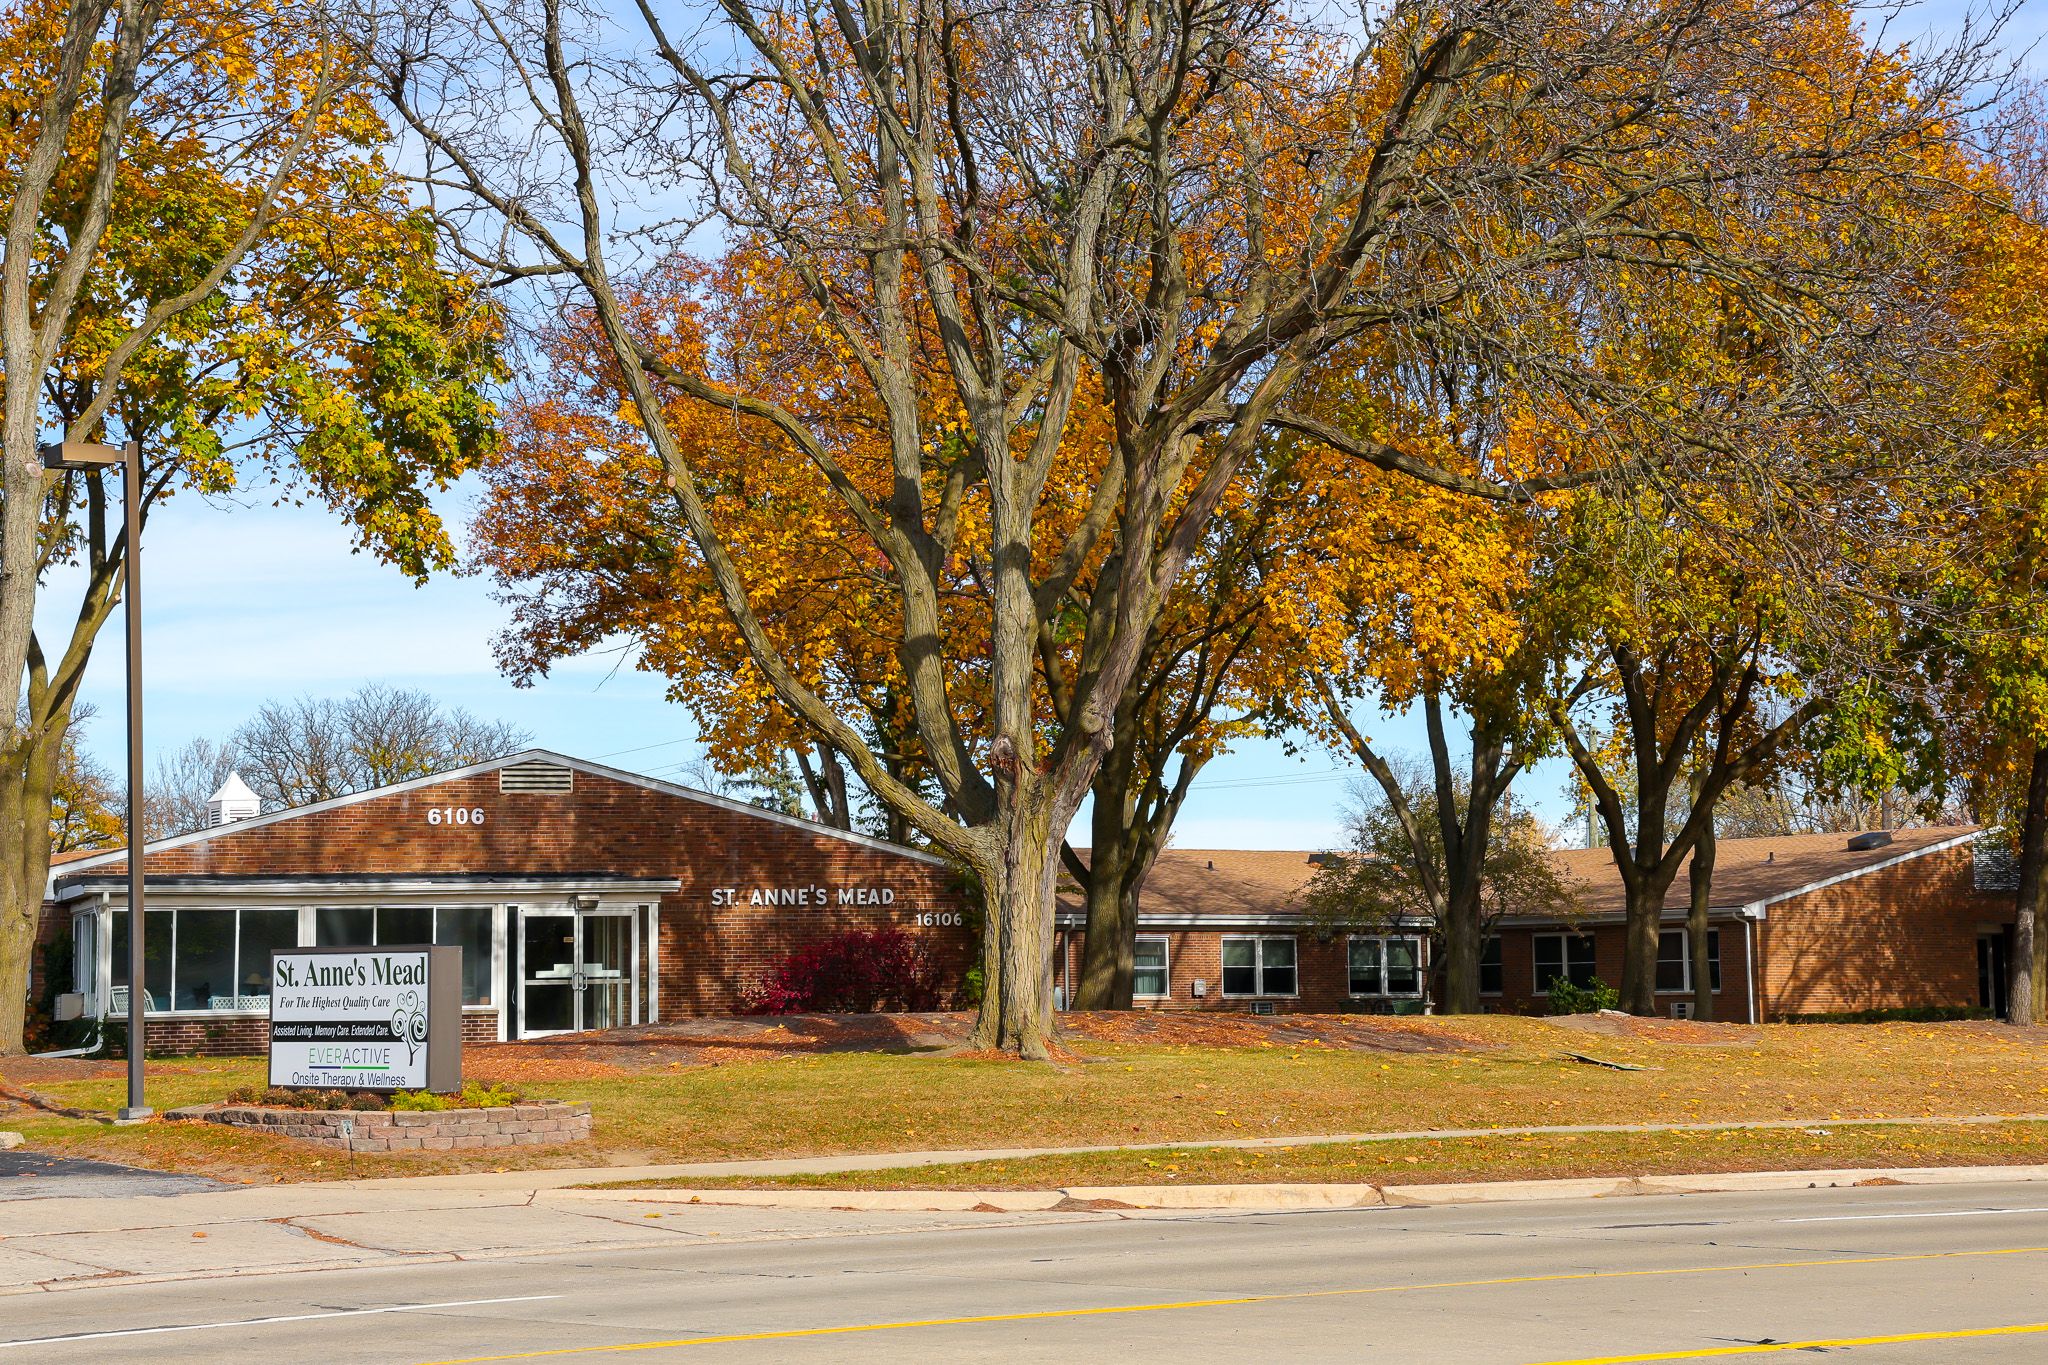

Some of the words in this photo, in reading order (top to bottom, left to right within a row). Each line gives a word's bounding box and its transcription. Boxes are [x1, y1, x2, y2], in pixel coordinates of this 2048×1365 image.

[427, 807, 485, 825] 6106
[711, 888, 740, 906] ST.
[750, 884, 827, 906] ANNE'S
[838, 888, 894, 905] MEAD
[915, 912, 963, 928] 16106
[276, 959, 299, 988] St.
[303, 957, 366, 987] Anne's
[371, 956, 426, 986] Mead
[279, 996, 295, 1009] For
[296, 996, 311, 1008] The
[311, 996, 341, 1011] Highest
[342, 995, 370, 1011] Quality
[372, 995, 391, 1008] Care
[273, 1025, 297, 1037] Assisted
[296, 1025, 314, 1038] Living.
[315, 1025, 337, 1038] Memory
[336, 1025, 350, 1036] Care.
[351, 1024, 376, 1036] Extended
[375, 1024, 390, 1036] Care.
[308, 1048, 391, 1064] EVERACTIVE
[292, 1072, 319, 1085] Onsite
[322, 1072, 356, 1086] Therapy
[359, 1072, 365, 1085] &
[367, 1073, 406, 1086] Wellness
